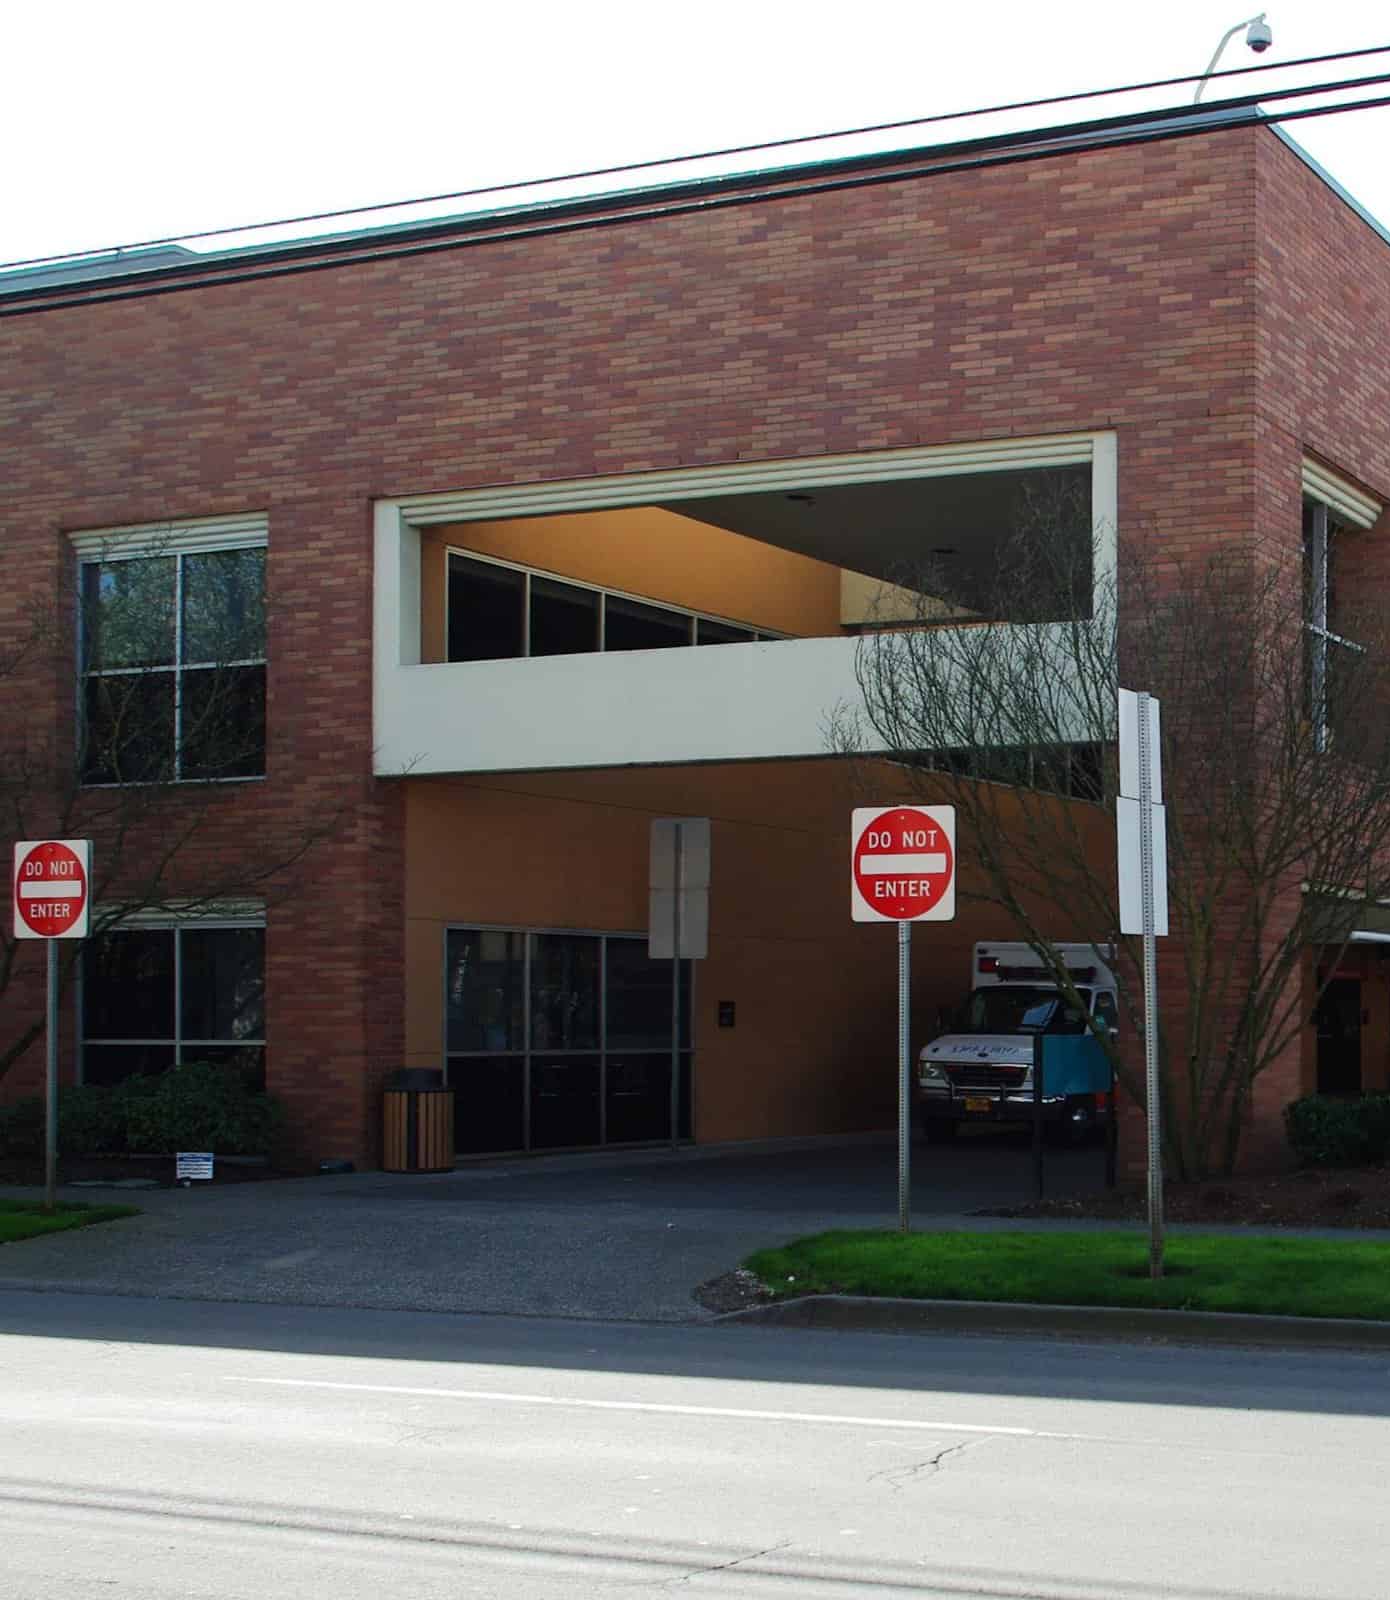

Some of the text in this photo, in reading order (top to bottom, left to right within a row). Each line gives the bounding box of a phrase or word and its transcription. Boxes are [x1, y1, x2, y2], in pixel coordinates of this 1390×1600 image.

[868, 830, 938, 849] DO NOT
[26, 860, 76, 876] DO NOT
[874, 880, 930, 898] ENTER
[30, 903, 70, 918] ENTER
